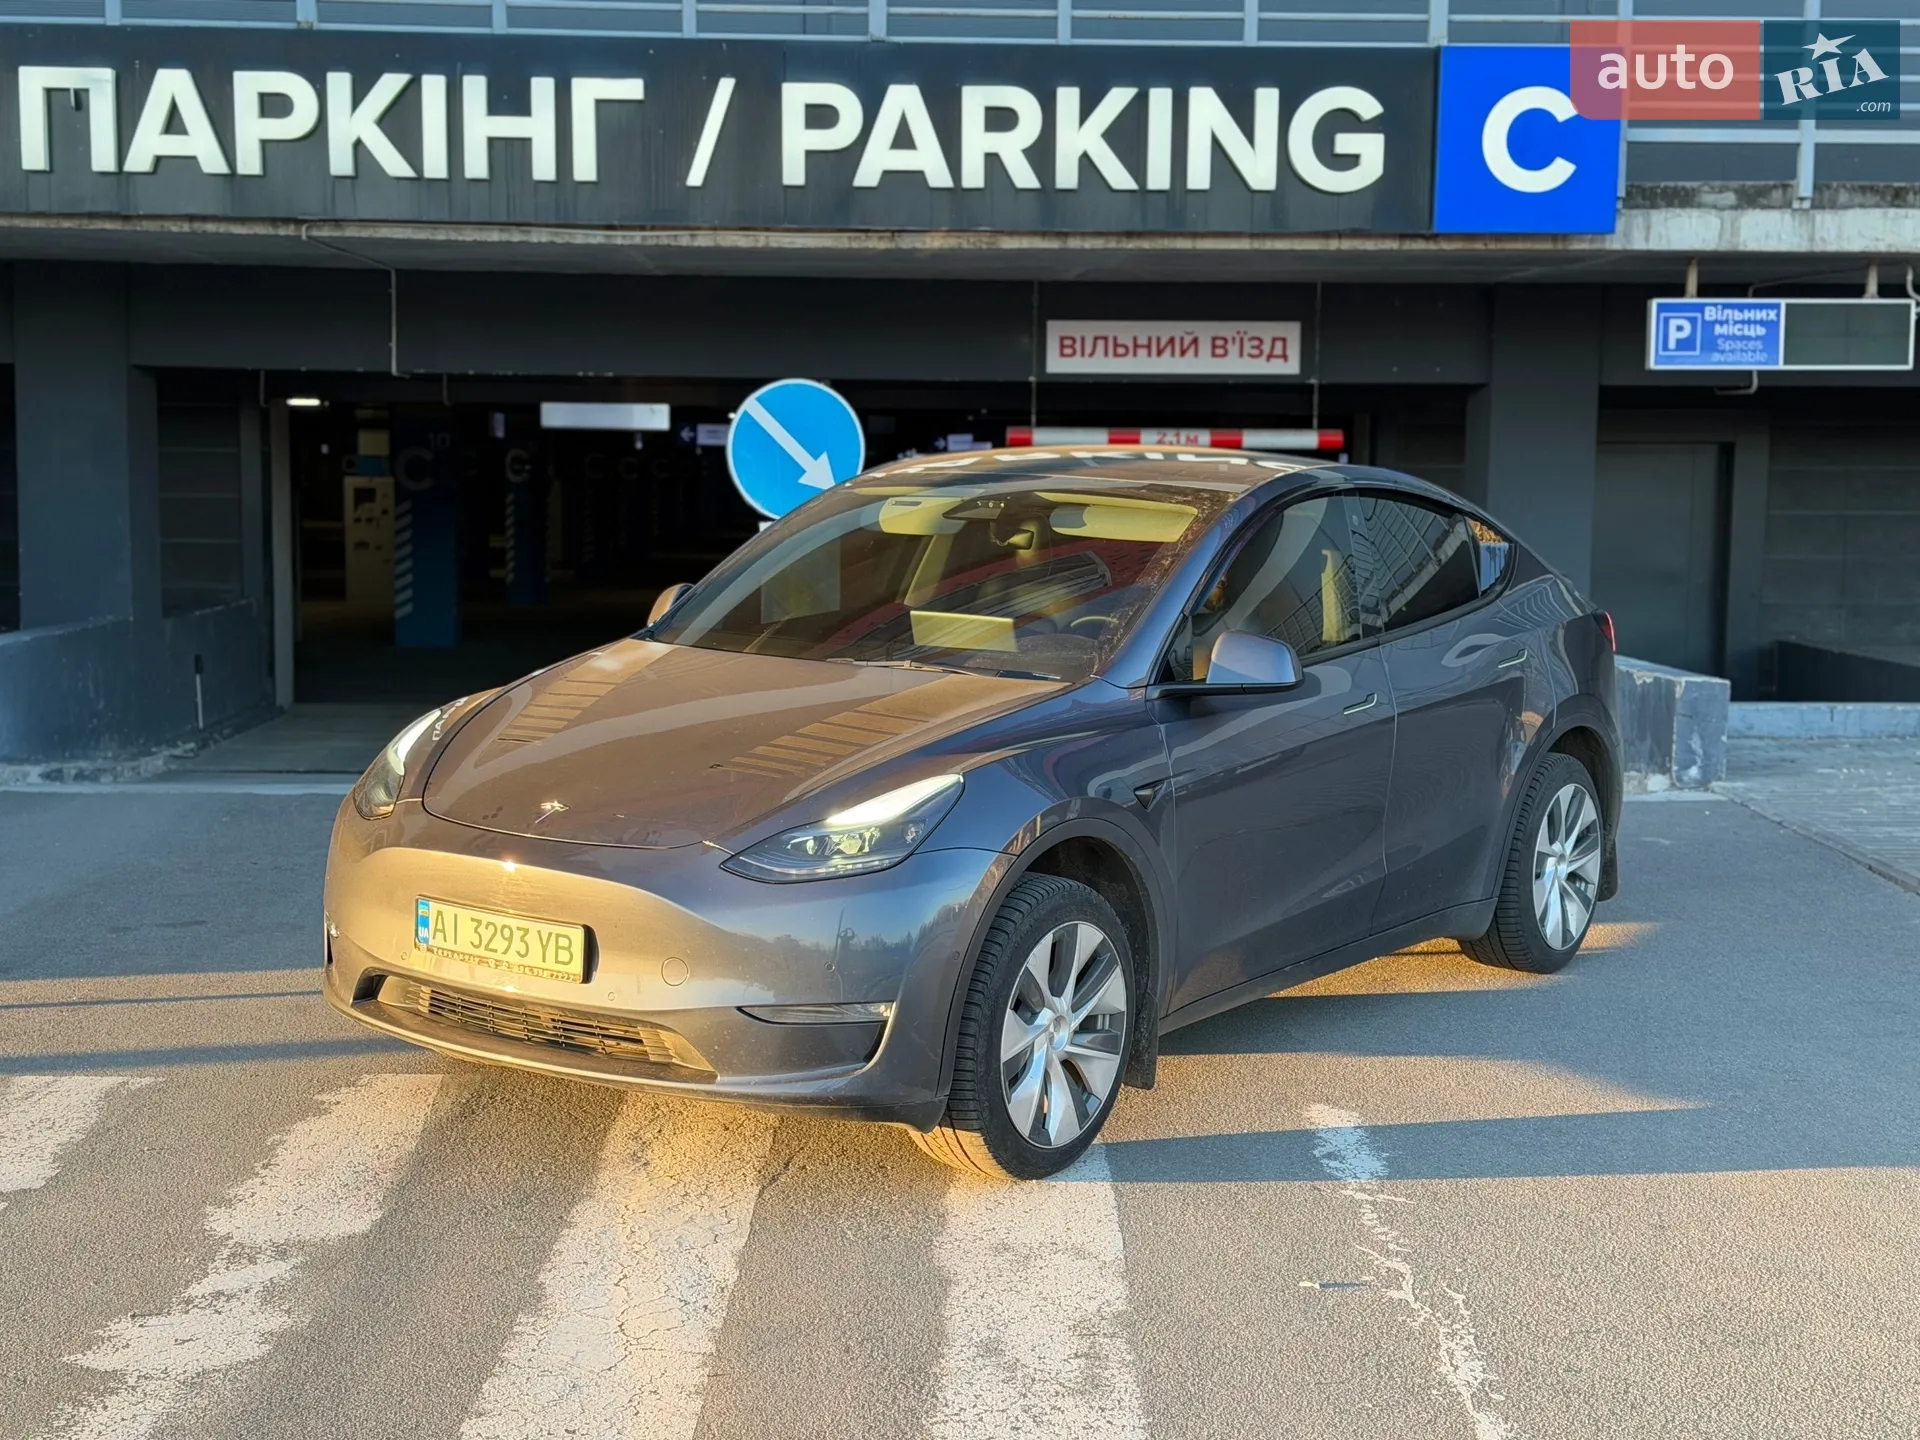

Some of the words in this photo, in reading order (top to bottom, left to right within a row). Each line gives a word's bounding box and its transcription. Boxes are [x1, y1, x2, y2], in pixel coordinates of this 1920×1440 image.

[18, 66, 645, 182] ПАРКІНГ
[781, 82, 1385, 193] PARKING
[1482, 86, 1579, 193] C
[1704, 305, 1778, 321] Вільних
[1714, 321, 1767, 337] місць
[1058, 331, 1199, 358] ВІЛЬНИЙ
[1210, 330, 1289, 363] В'ЇЗД
[1667, 318, 1692, 350] P
[1717, 338, 1763, 351] Spaces
[1711, 351, 1768, 362] available
[432, 910, 458, 945] AI
[470, 917, 530, 958] 3293
[537, 930, 574, 966] YB
